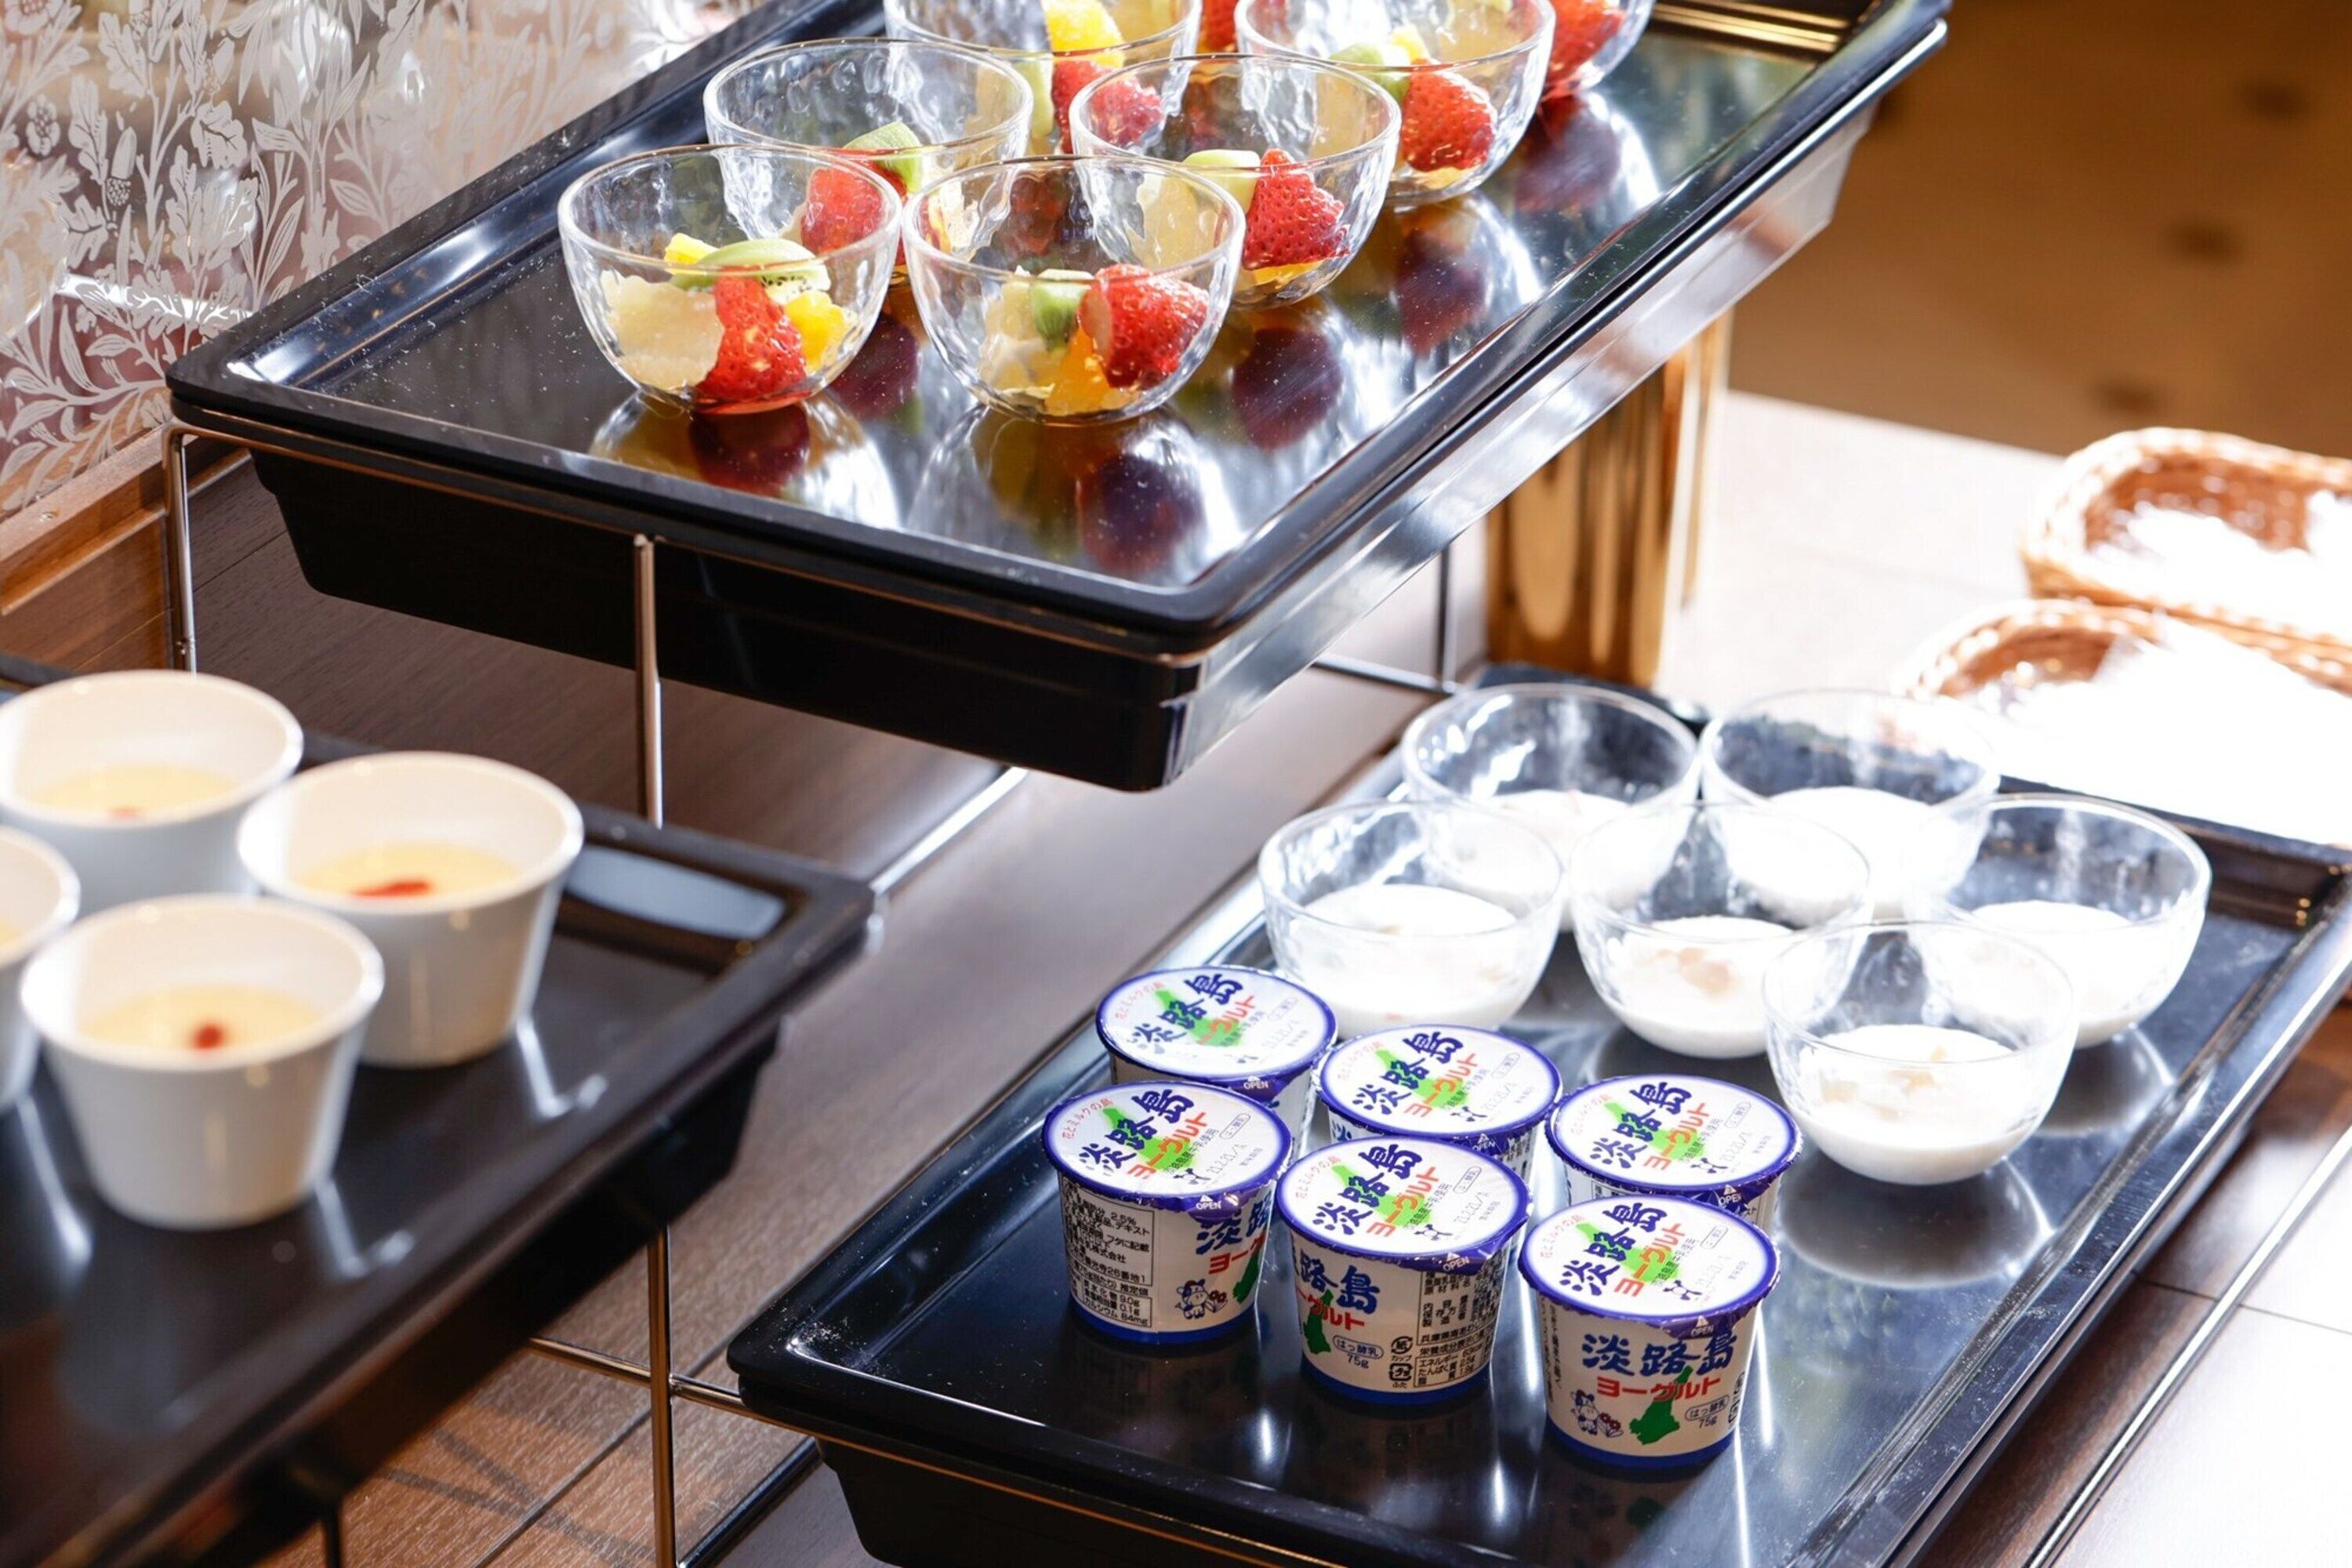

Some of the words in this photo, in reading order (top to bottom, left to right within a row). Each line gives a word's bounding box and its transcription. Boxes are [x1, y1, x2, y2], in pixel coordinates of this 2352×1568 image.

[1243, 1080, 1269, 1090] OPEN
[1352, 1032, 1464, 1115] 淡路島
[1404, 1052, 1478, 1118] ヨーグルト
[1079, 1089, 1195, 1176] 淡路島
[1127, 1112, 1208, 1180] ヨーグルト
[1590, 1082, 1692, 1168] 淡路島
[1642, 1102, 1710, 1171] ヨーグルト
[1196, 1200, 1221, 1210] OPEN
[1312, 1144, 1423, 1236] 淡路島
[1366, 1167, 1439, 1238] ヨーグルト
[1443, 1255, 1471, 1272] OPEN
[1559, 1203, 1668, 1297] 淡路島
[1613, 1223, 1686, 1298] ヨーグルト
[1347, 1353, 1370, 1370] 75g
[1581, 1332, 1738, 1377] 淡路島
[1690, 1324, 1715, 1337] OPEN
[1596, 1375, 1722, 1403] ヨーグルト
